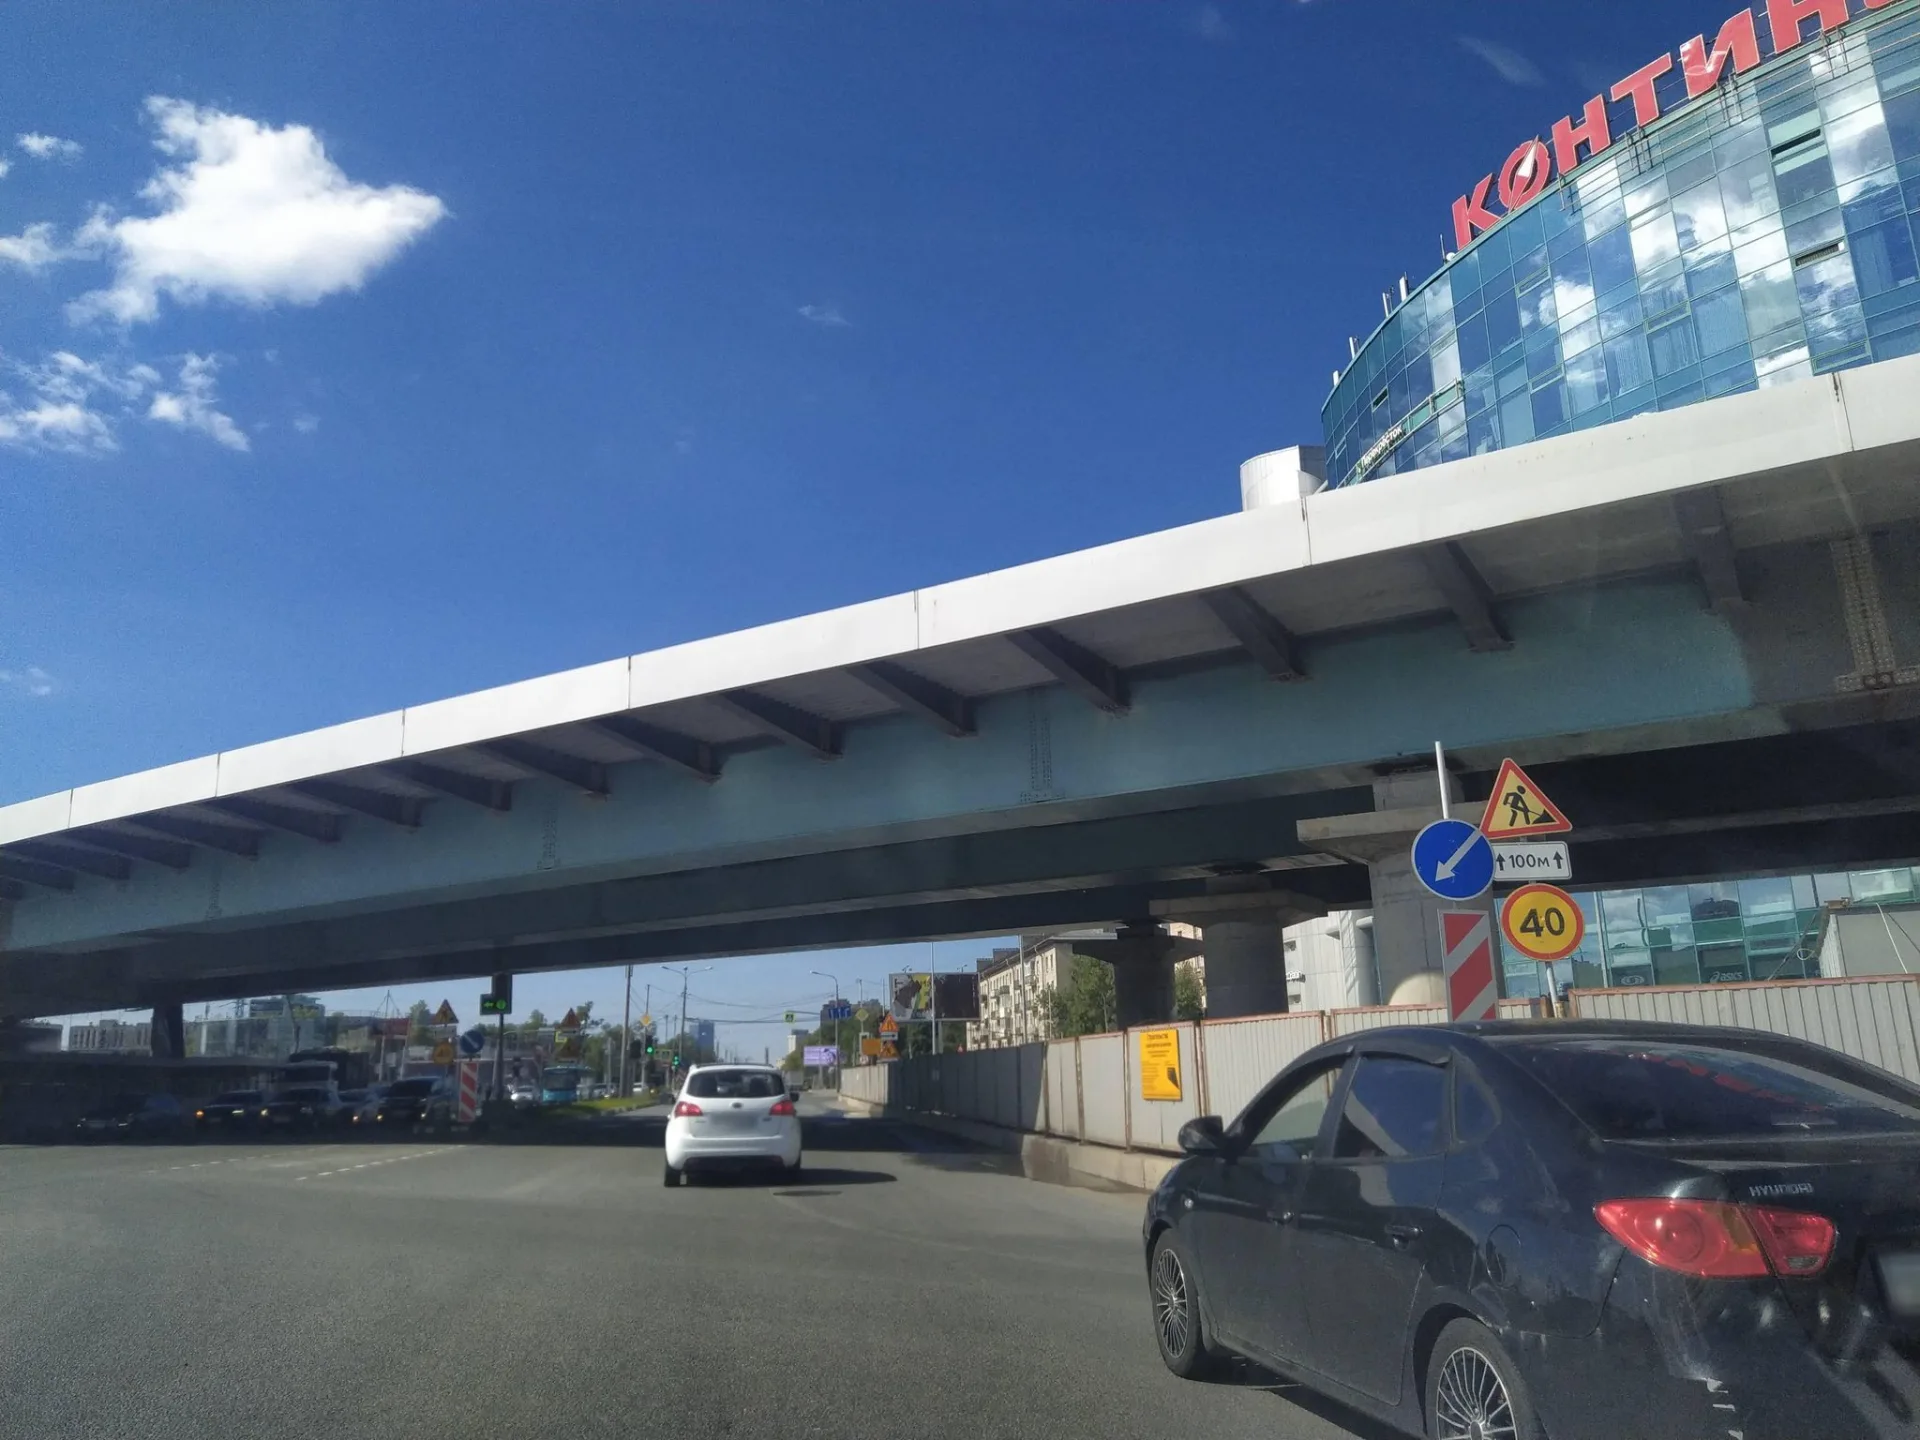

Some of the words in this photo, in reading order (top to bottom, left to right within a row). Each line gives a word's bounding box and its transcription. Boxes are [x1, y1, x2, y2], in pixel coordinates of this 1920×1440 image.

[1452, 0, 1894, 250] КОНТИН
[1520, 907, 1565, 937] 40
[1749, 1183, 1813, 1197] HYUNDAI
